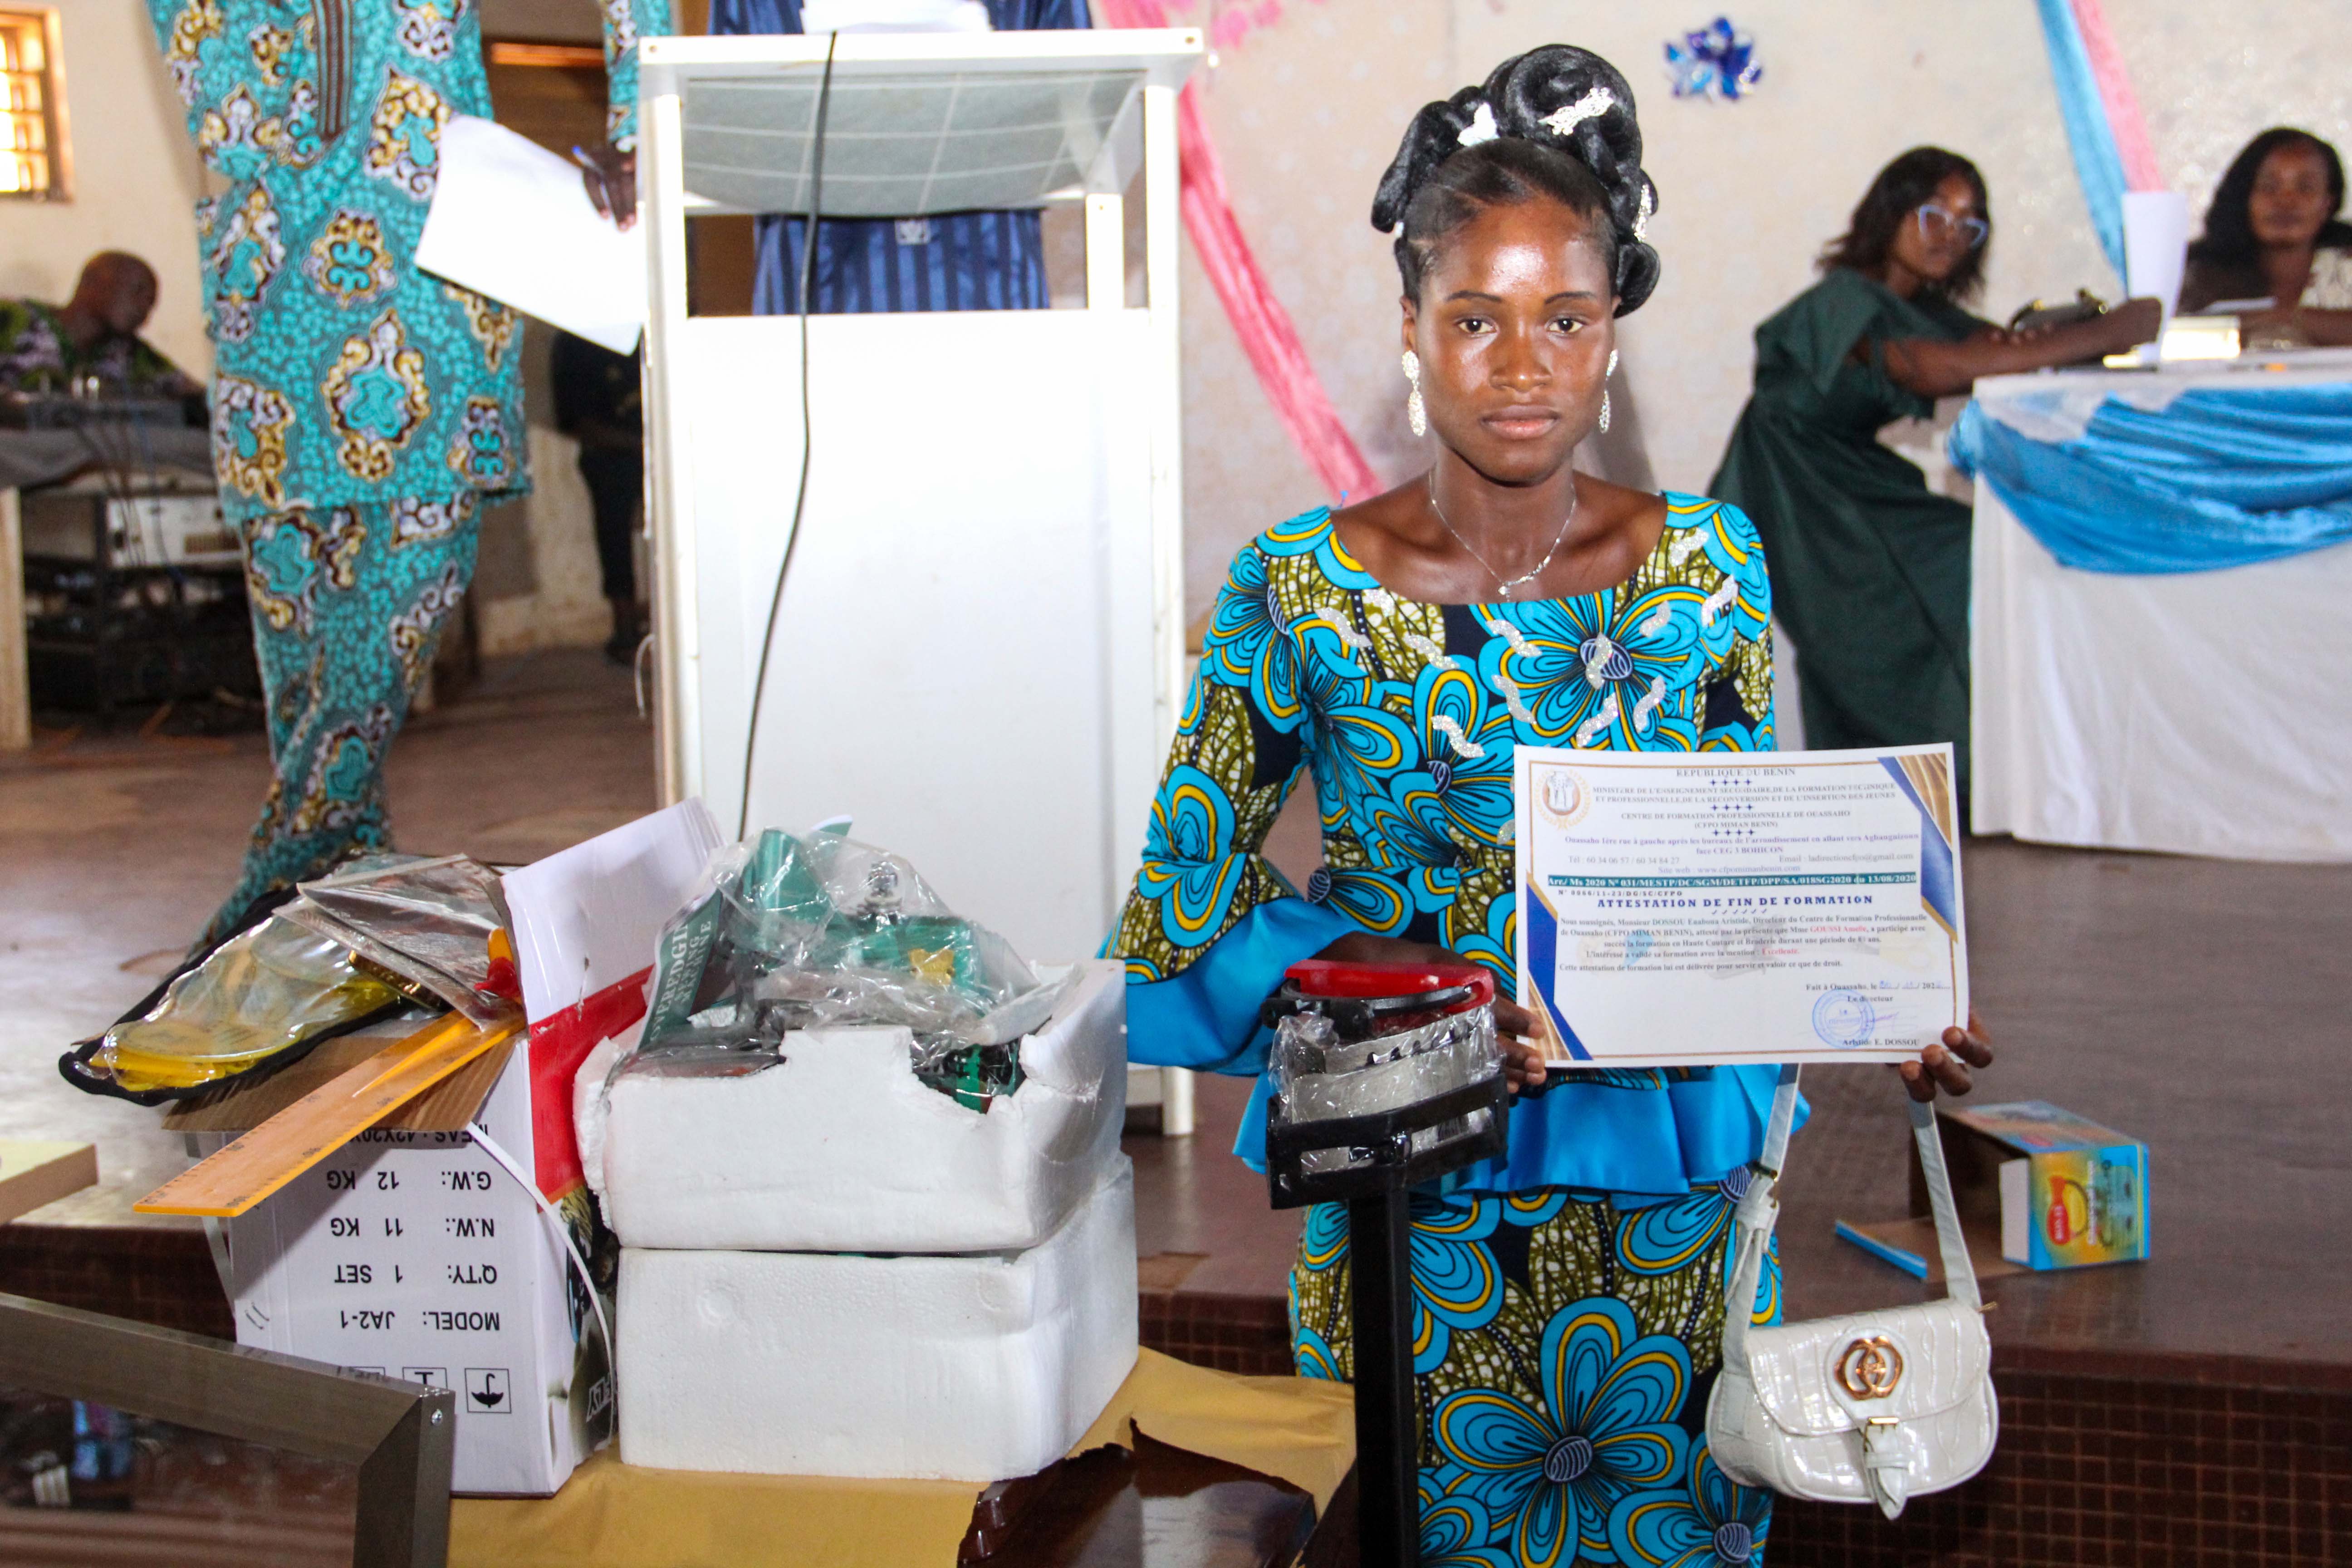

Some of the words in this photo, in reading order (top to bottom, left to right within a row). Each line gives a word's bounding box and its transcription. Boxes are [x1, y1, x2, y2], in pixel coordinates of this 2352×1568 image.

[1677, 768, 1742, 777] REPUBLIQUE
[1764, 767, 1794, 775] BENIN
[1640, 837, 1665, 845] gauche
[1735, 834, 1743, 843] de
[1784, 896, 1872, 904] FORMATION
[327, 1171, 355, 1190] KG
[378, 1171, 399, 1190] 12
[442, 1171, 492, 1190] G.W.:
[331, 1218, 359, 1236] KG
[385, 1218, 403, 1236] 11
[446, 1218, 494, 1236] N.W.:
[334, 1265, 372, 1283] SET
[395, 1265, 402, 1283] 1
[448, 1264, 497, 1284] Q'TY:
[340, 1311, 395, 1329] JA2-1
[423, 1311, 500, 1330] MODEL:
